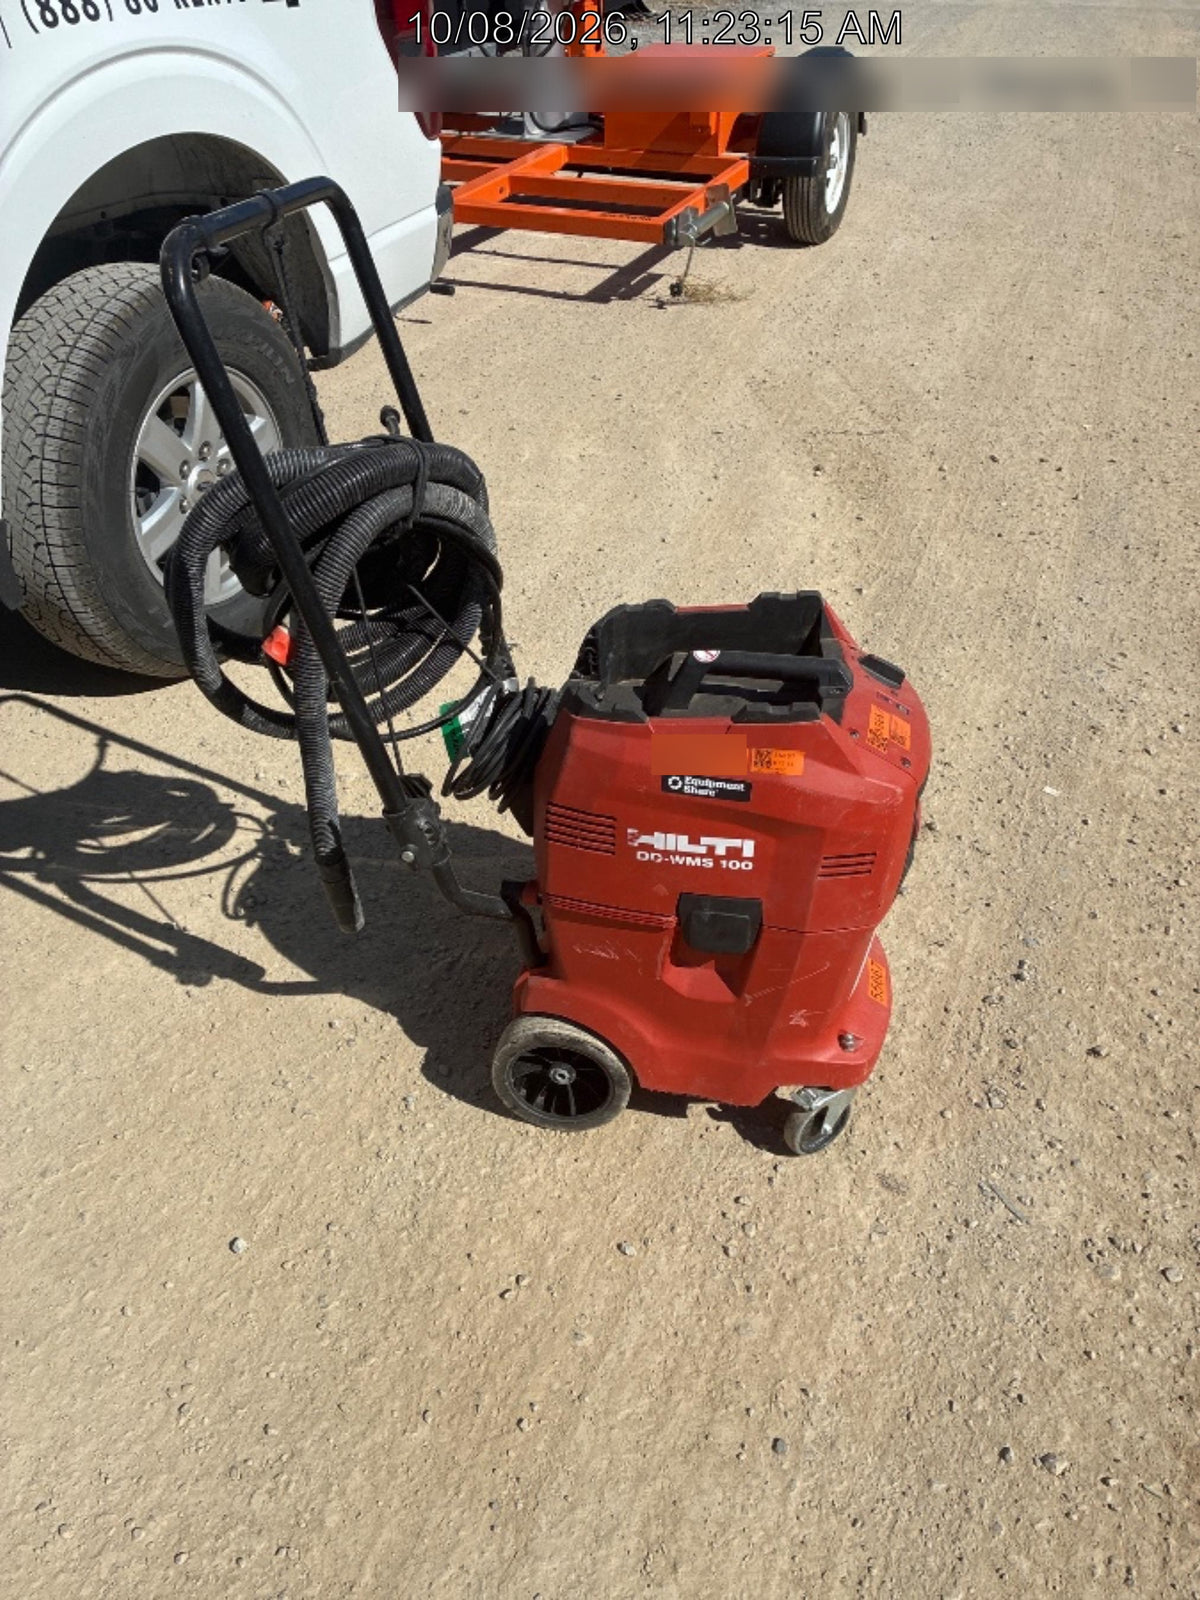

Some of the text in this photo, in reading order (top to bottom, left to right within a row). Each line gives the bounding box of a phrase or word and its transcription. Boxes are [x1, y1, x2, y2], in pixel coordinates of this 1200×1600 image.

[683, 775, 745, 792] Equipment
[627, 828, 755, 858] HILTI
[720, 859, 753, 870] 100
